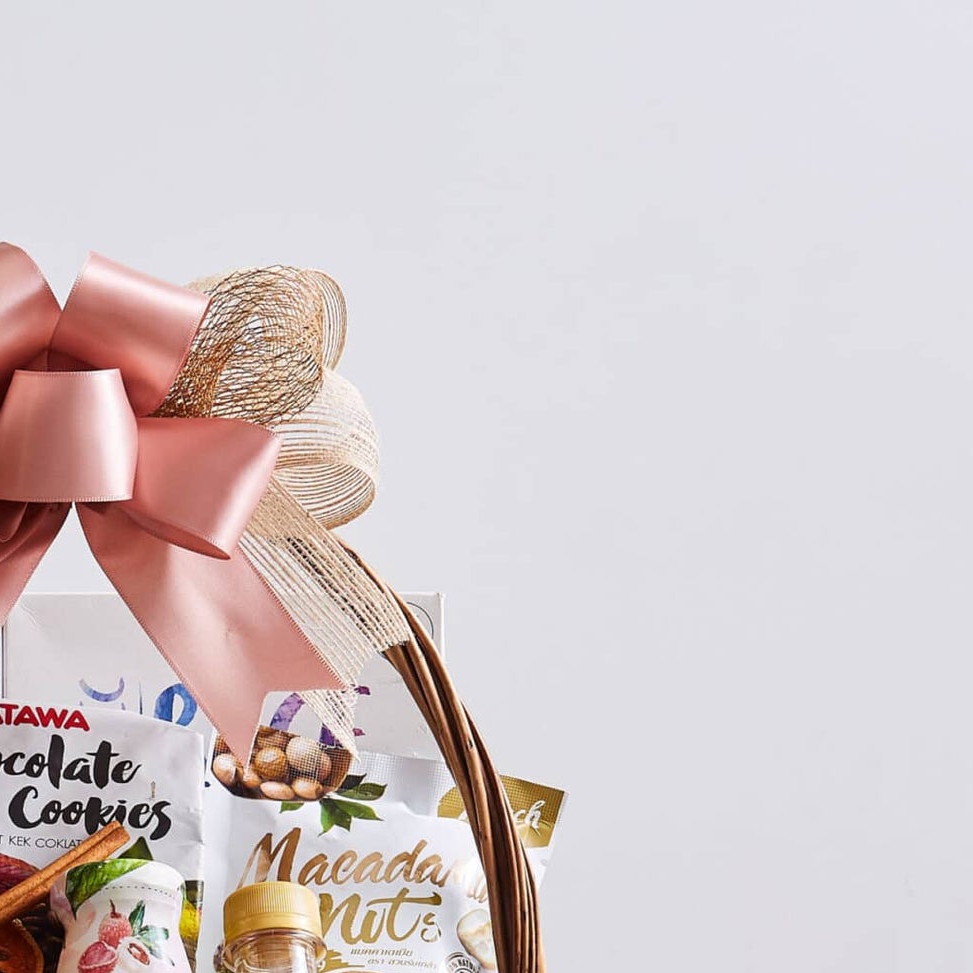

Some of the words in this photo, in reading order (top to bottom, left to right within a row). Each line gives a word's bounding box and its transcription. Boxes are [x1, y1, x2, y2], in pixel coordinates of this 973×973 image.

[8, 786, 172, 840] Cookies
[8, 835, 31, 848] KEK
[35, 837, 81, 850] COKLAT
